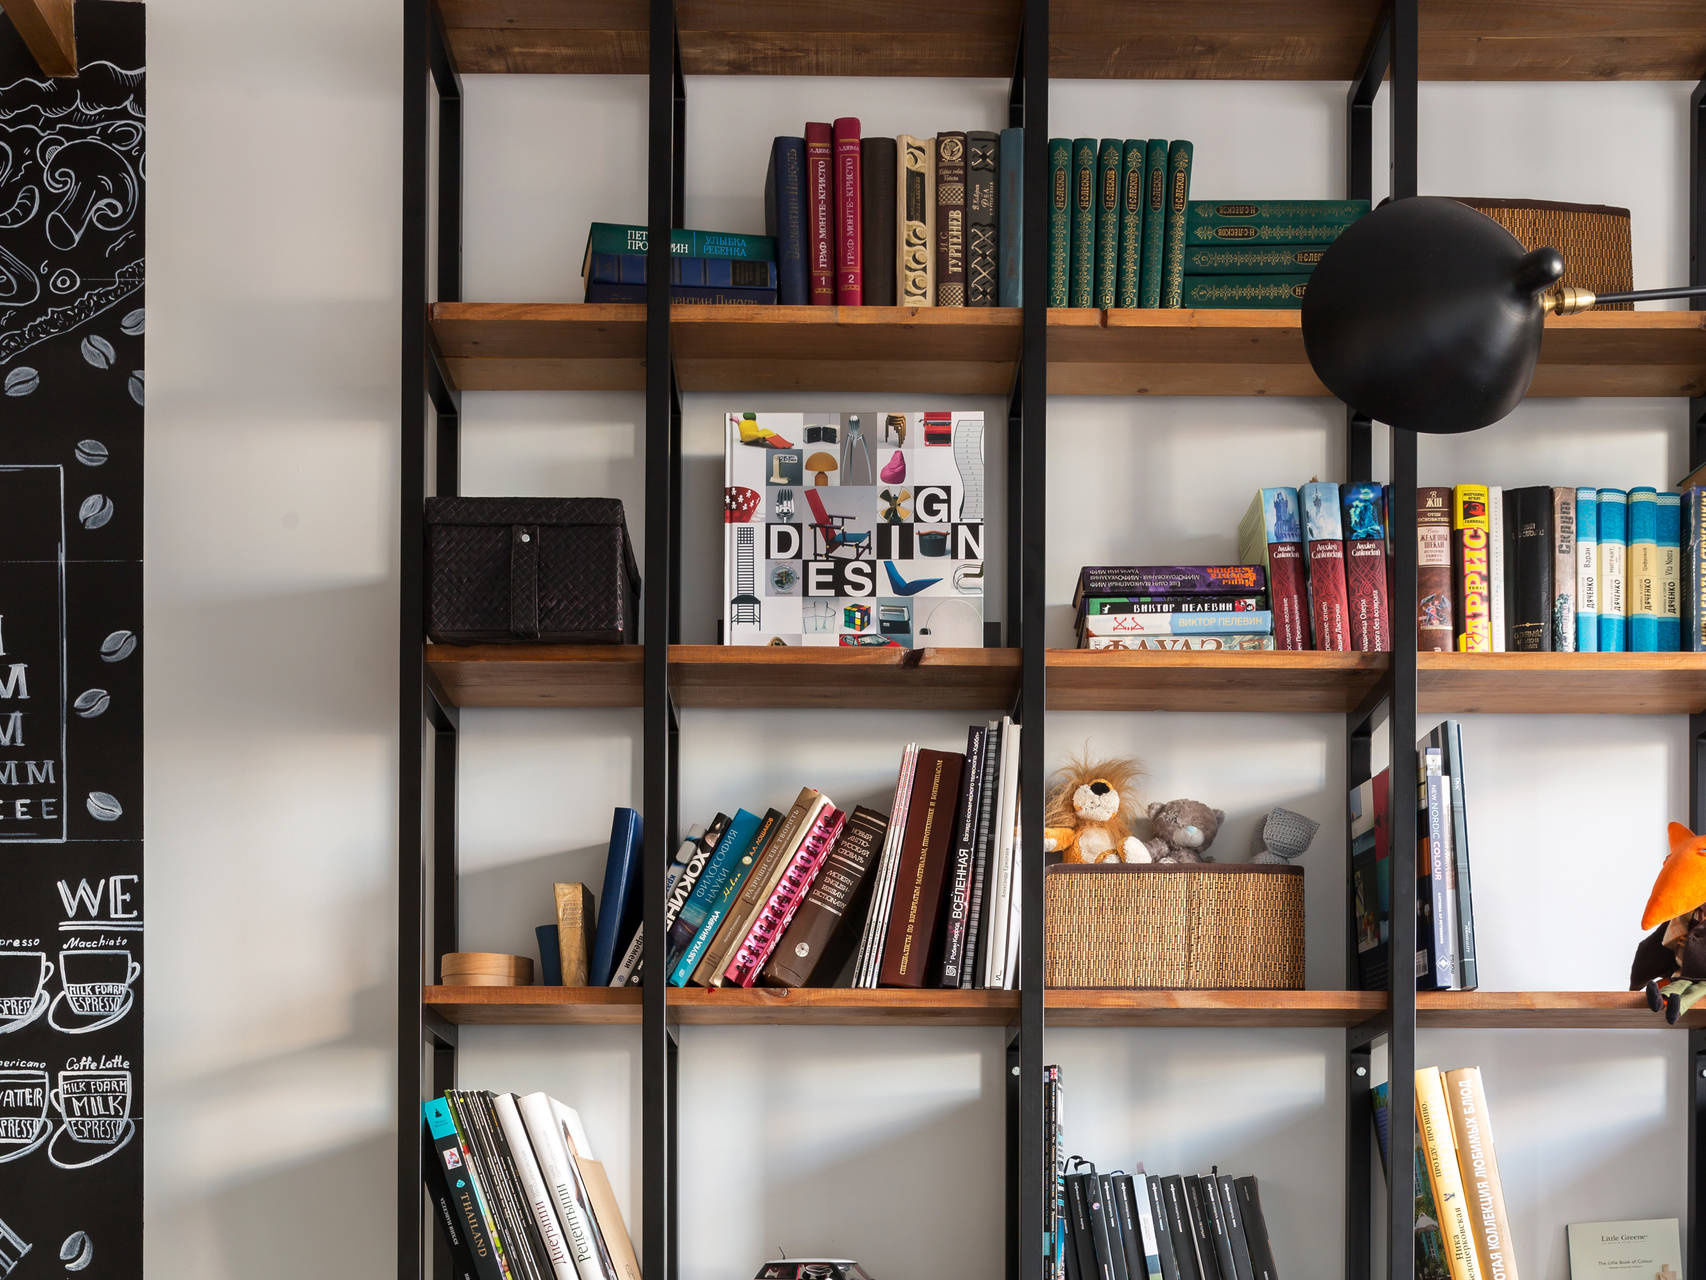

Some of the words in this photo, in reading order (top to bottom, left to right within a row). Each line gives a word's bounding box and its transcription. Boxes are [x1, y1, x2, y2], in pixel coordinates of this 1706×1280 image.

[818, 160, 827, 240] МОНТЕ-КРИСТО
[845, 158, 854, 237] МОНТЕ-КРИСТО
[627, 229, 648, 241] ПЕТ
[705, 235, 748, 248] УЛЫБКА
[948, 209, 962, 274] ТУРГЕНЕВ
[818, 242, 828, 269] ГРАФ
[845, 239, 855, 266] ГРАФ
[848, 274, 855, 284] 2
[1558, 500, 1573, 555] Скрут
[1583, 547, 1592, 568] Варан
[1665, 565, 1674, 576] Vita
[1133, 604, 1175, 613] ВИКТОР
[1181, 602, 1233, 612] ПЕЛЕВИН
[1586, 576, 1595, 609] ДЯЧЕНКО
[1612, 579, 1621, 612] ДЯЧЕНКО
[1643, 578, 1653, 611] ДЯЧЕНКО
[1667, 581, 1677, 614] ДЯЧЕНКО
[1178, 617, 1216, 627] ВИКТОР
[1217, 616, 1263, 626] ПЕЛЕВИН
[1283, 624, 1292, 651] оследнее
[929, 759, 944, 801] БОЕПРИПАСАМ
[755, 816, 775, 847] ЛОШАКОВ
[852, 827, 873, 842] НОВЫЙ
[921, 807, 936, 847] ПИРОТЕХНИКЕ
[1431, 802, 1440, 840] NORDIC
[696, 828, 739, 899] ФИЛОСОФИЯ
[745, 860, 770, 900] РАЗРЕШИ
[765, 840, 782, 866] СЕБЕ
[776, 806, 801, 845] ТВОРИТЬ
[1433, 841, 1442, 881] COLOUR
[56, 874, 140, 919] WE
[705, 868, 728, 904] НАУКИ
[812, 889, 847, 909] DICTIONARY
[951, 848, 970, 919] ВСЕЛЕННАЯ
[62, 934, 128, 950] Macchiato
[686, 938, 704, 966] АЗБУКА
[699, 909, 721, 943] БИЛЬЯРДА
[905, 923, 914, 934] ПО
[899, 934, 914, 976] СПЕЦИАЛИСТЫ
[73, 996, 121, 1012] ESPRESSO
[98, 1054, 131, 1070] Latte
[63, 1081, 86, 1094] MILK
[1458, 1079, 1473, 1119] БЛЮД
[71, 1095, 124, 1117] MILK
[71, 1120, 122, 1139] ESPRESSO
[1425, 1125, 1435, 1141] ПРО
[1466, 1119, 1487, 1180] ЛЮБИМЫХ
[1434, 1161, 1442, 1178] ПРО
[460, 1191, 487, 1258] THAILAND
[1476, 1181, 1501, 1250] КОЛЛЕКЦИЯ
[1456, 1233, 1465, 1261] Ника
[1601, 1234, 1619, 1242] Little
